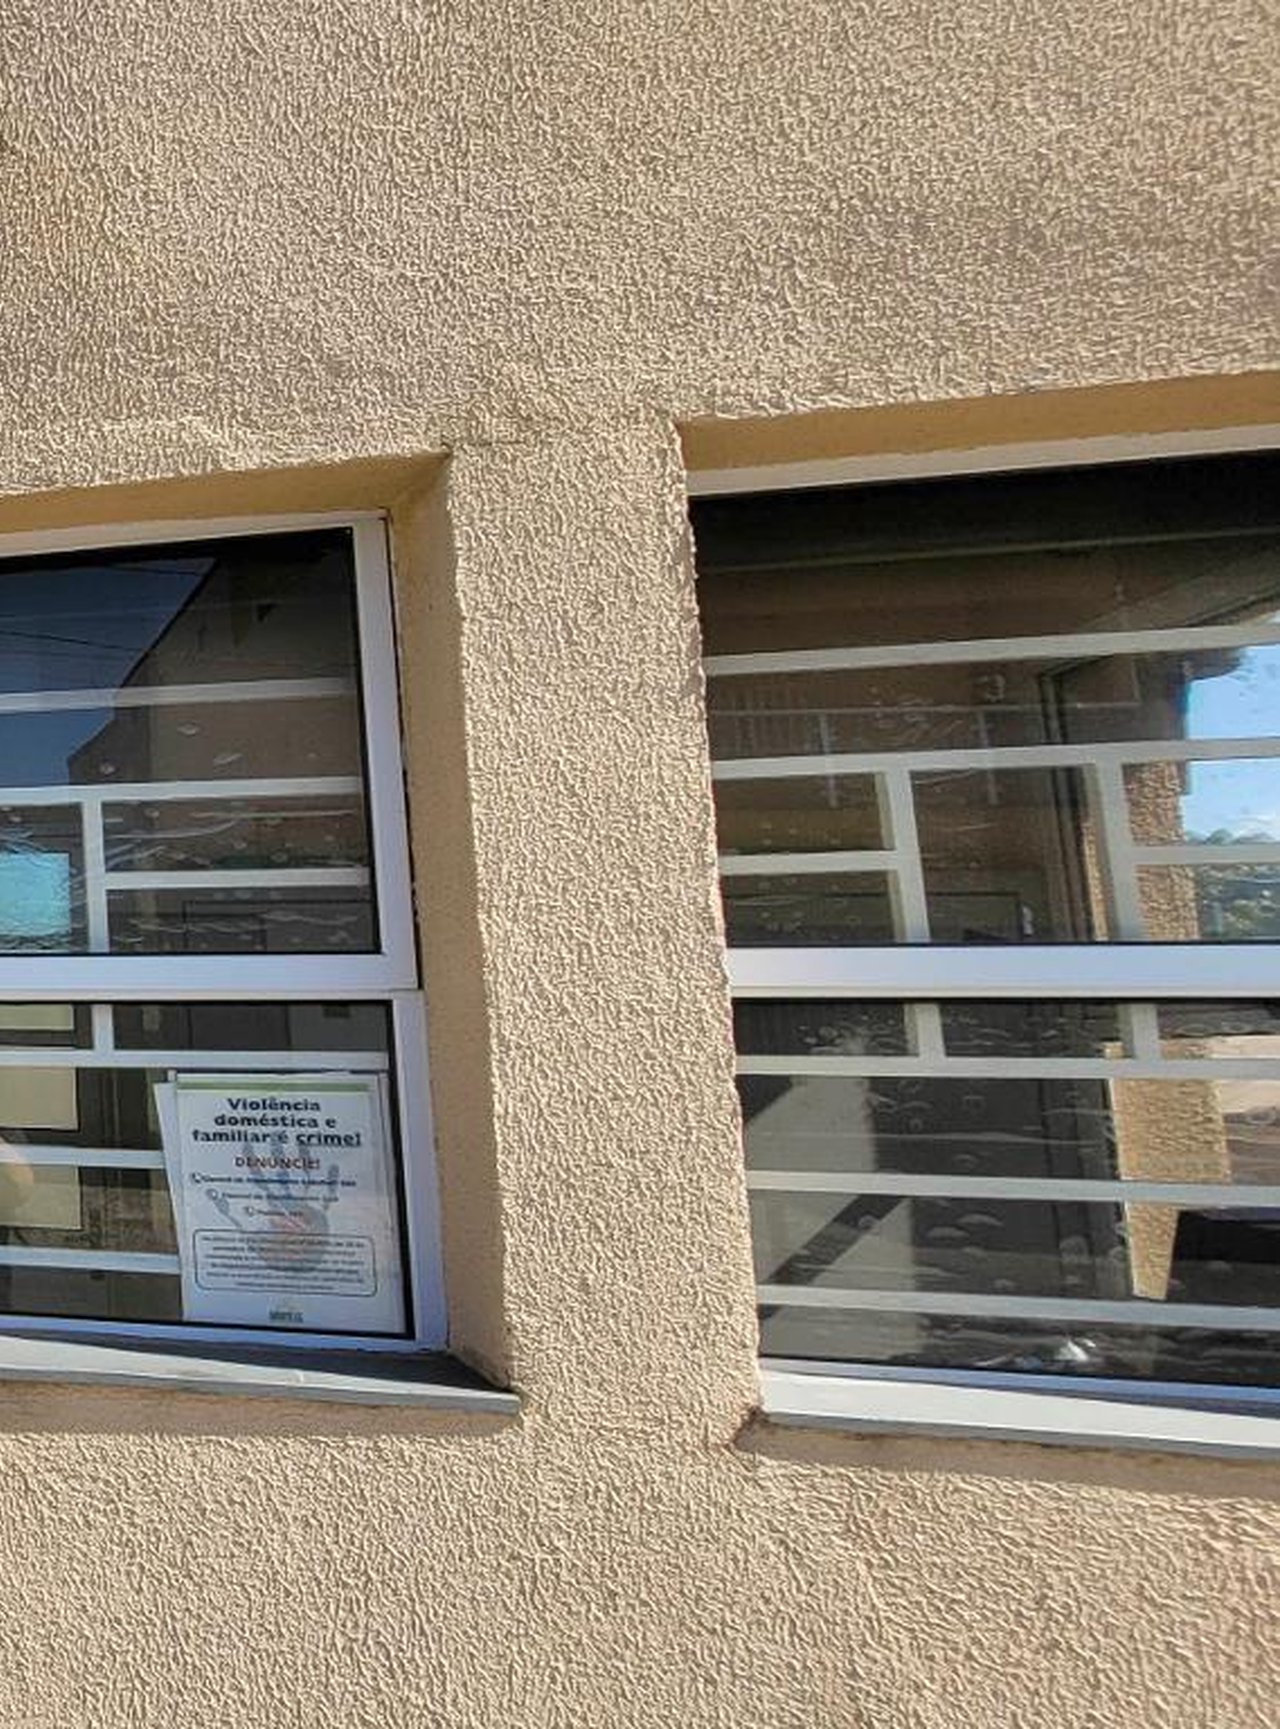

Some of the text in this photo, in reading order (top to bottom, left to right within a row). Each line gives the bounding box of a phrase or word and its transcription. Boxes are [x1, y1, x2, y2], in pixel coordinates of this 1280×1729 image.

[227, 1096, 321, 1112] Violência
[214, 1114, 337, 1129] doméstica e
[192, 1129, 271, 1144] familiar
[277, 1130, 289, 1144] é
